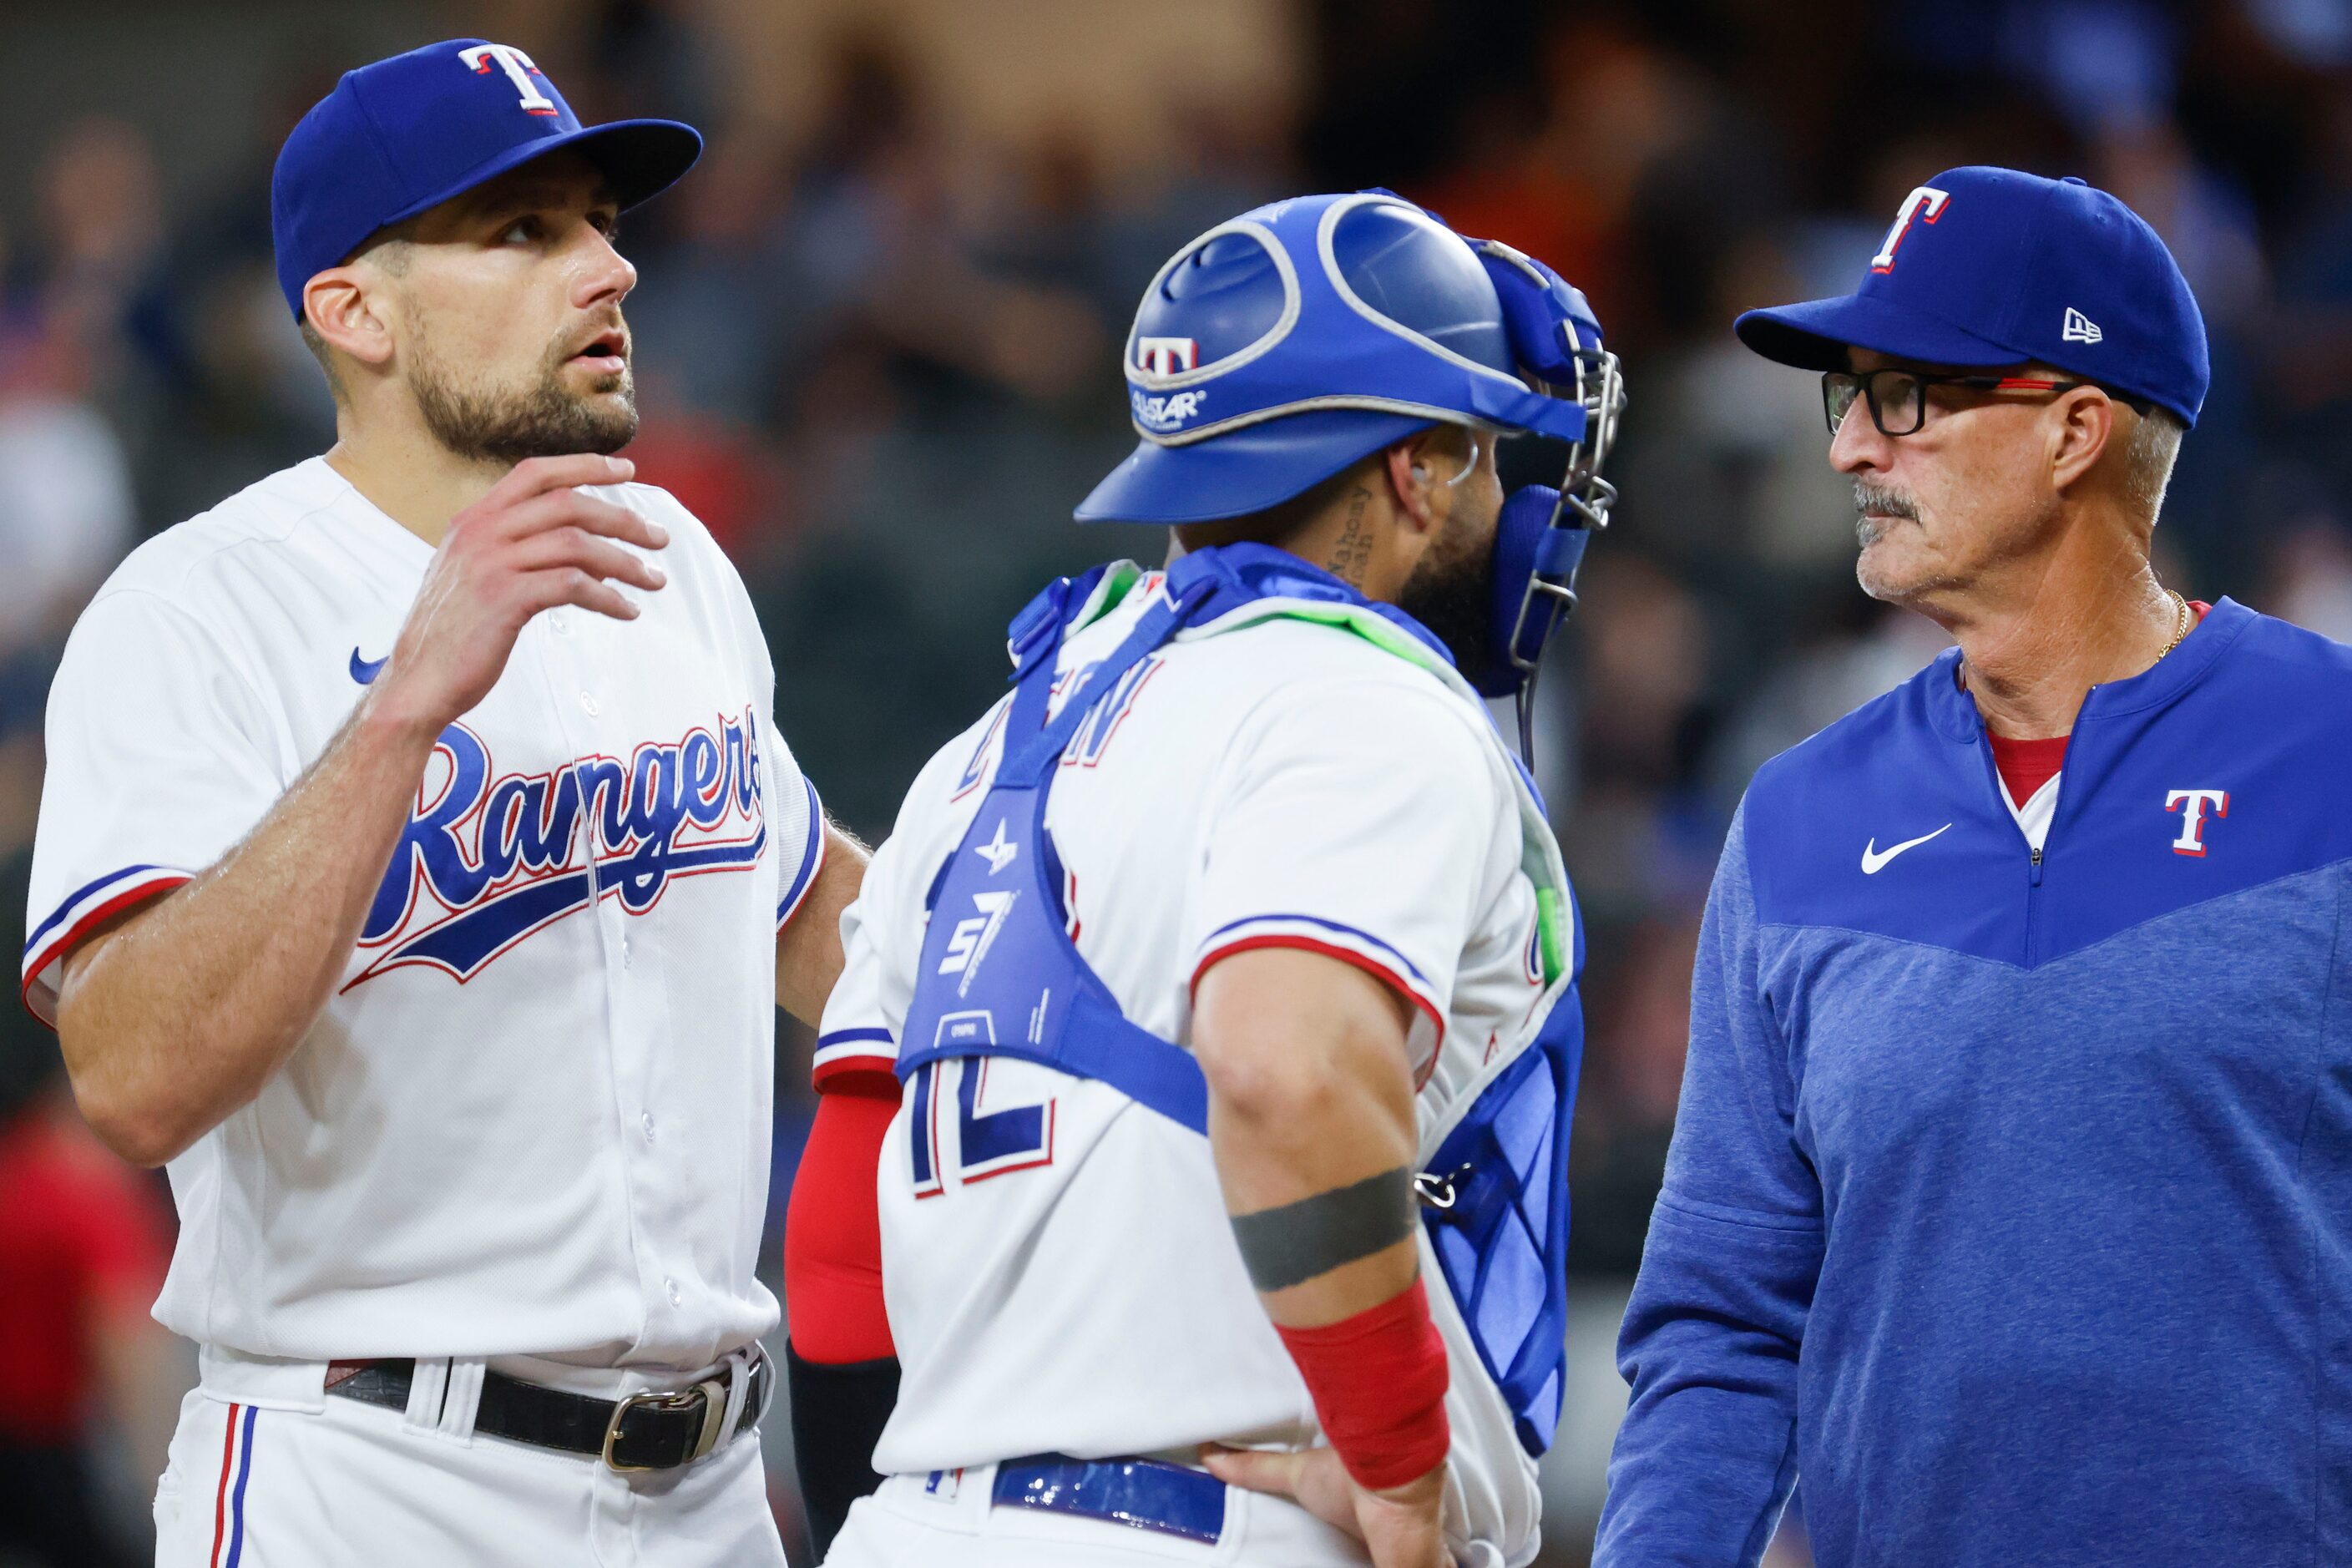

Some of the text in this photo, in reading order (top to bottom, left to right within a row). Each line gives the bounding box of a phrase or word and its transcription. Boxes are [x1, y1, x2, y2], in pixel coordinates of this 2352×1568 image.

[458, 43, 558, 116] T
[1870, 186, 1951, 274] T
[2165, 789, 2230, 858] T
